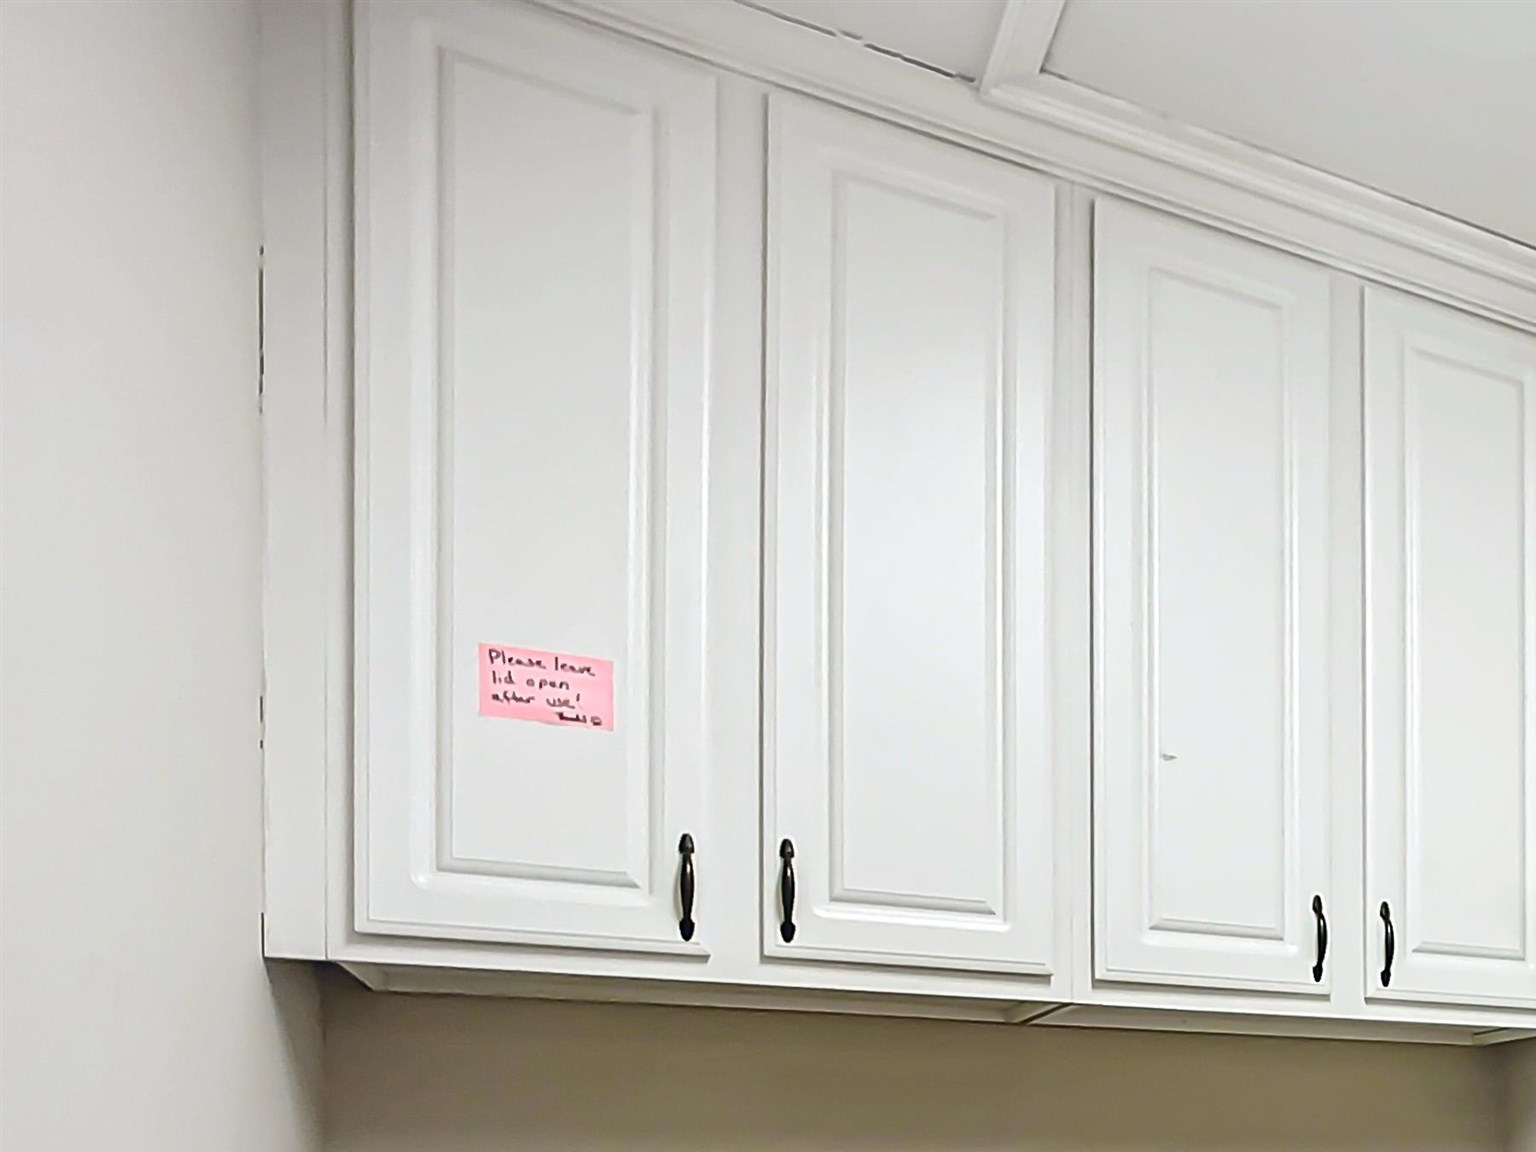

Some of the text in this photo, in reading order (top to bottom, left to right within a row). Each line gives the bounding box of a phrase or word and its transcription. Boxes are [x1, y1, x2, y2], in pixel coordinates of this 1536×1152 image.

[488, 648, 596, 676] Please leave
[492, 670, 570, 690] lid open
[491, 690, 535, 704] after
